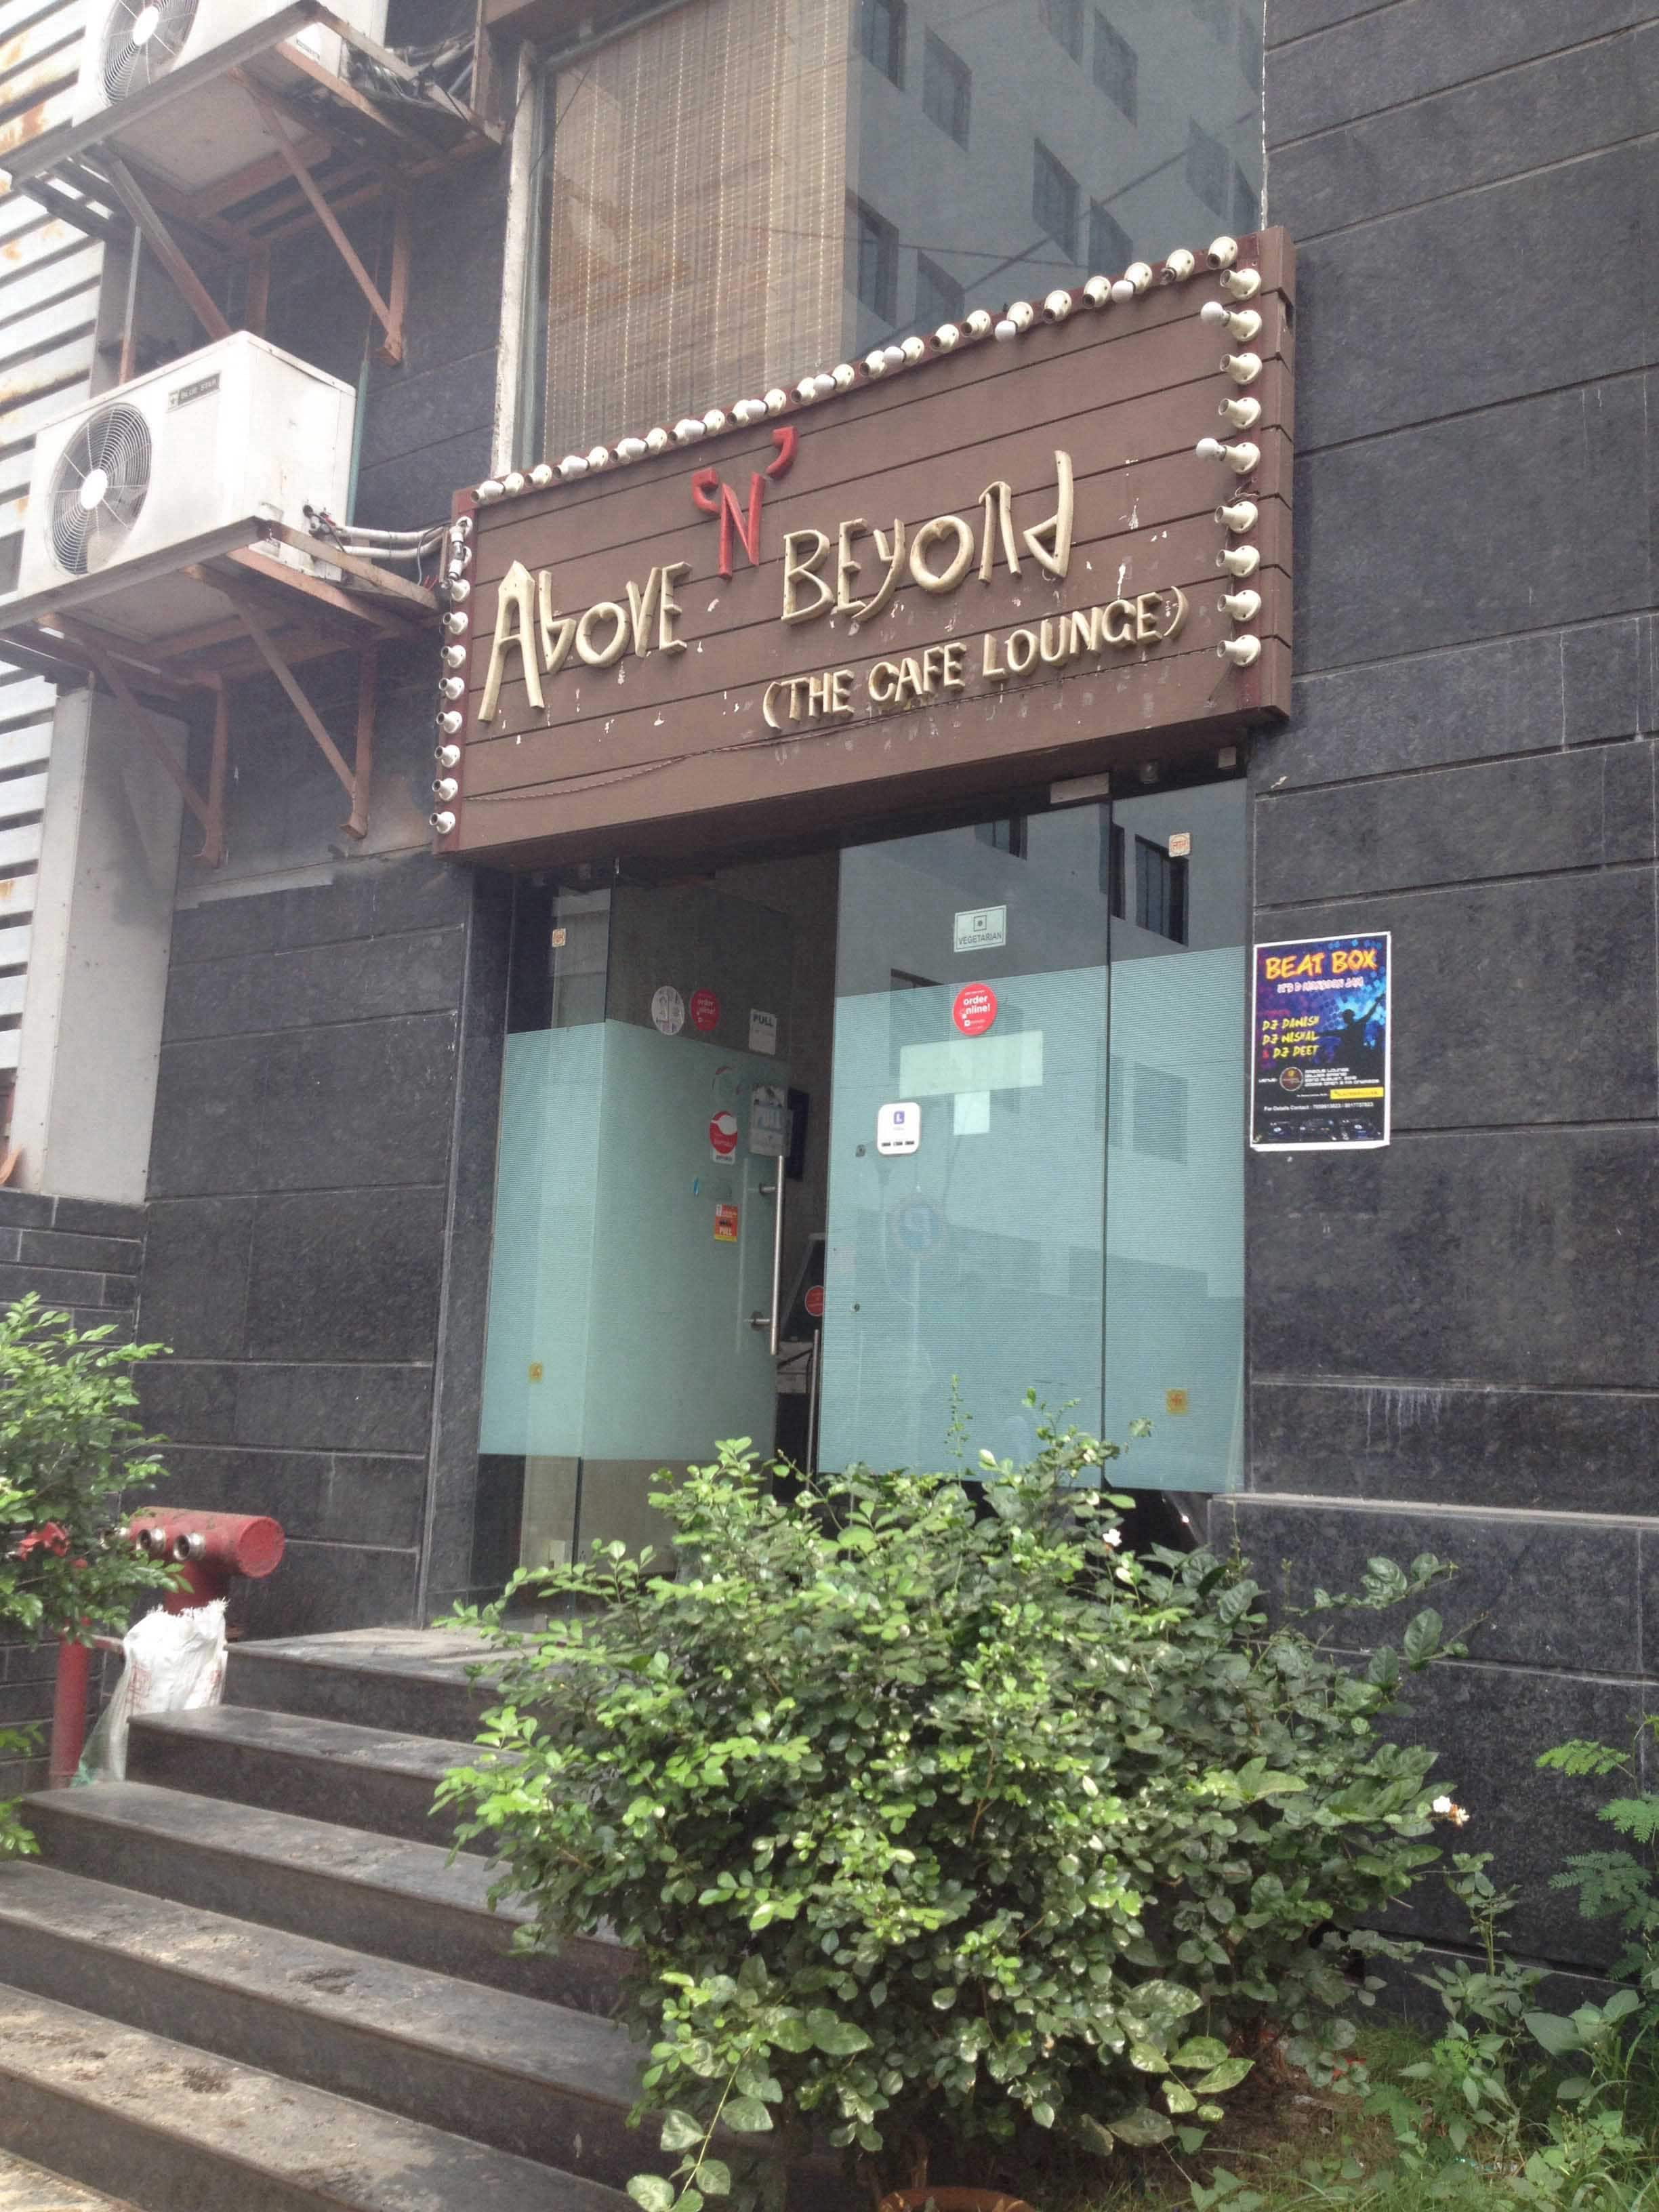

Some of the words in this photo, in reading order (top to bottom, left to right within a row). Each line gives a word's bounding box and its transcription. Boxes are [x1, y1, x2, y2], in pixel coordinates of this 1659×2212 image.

[762, 668, 855, 731] (THE
[867, 641, 968, 705] CAFE
[982, 585, 1189, 679] LOUNGE)
[958, 931, 1002, 945] VEGETARIAN
[1265, 951, 1326, 980] BEAT
[1330, 949, 1378, 975] BOX
[962, 994, 988, 1006] order
[753, 1014, 774, 1027] PULL
[1262, 1019, 1279, 1031] DJ
[1262, 1033, 1279, 1046] DJ
[1273, 1047, 1290, 1059] DJ
